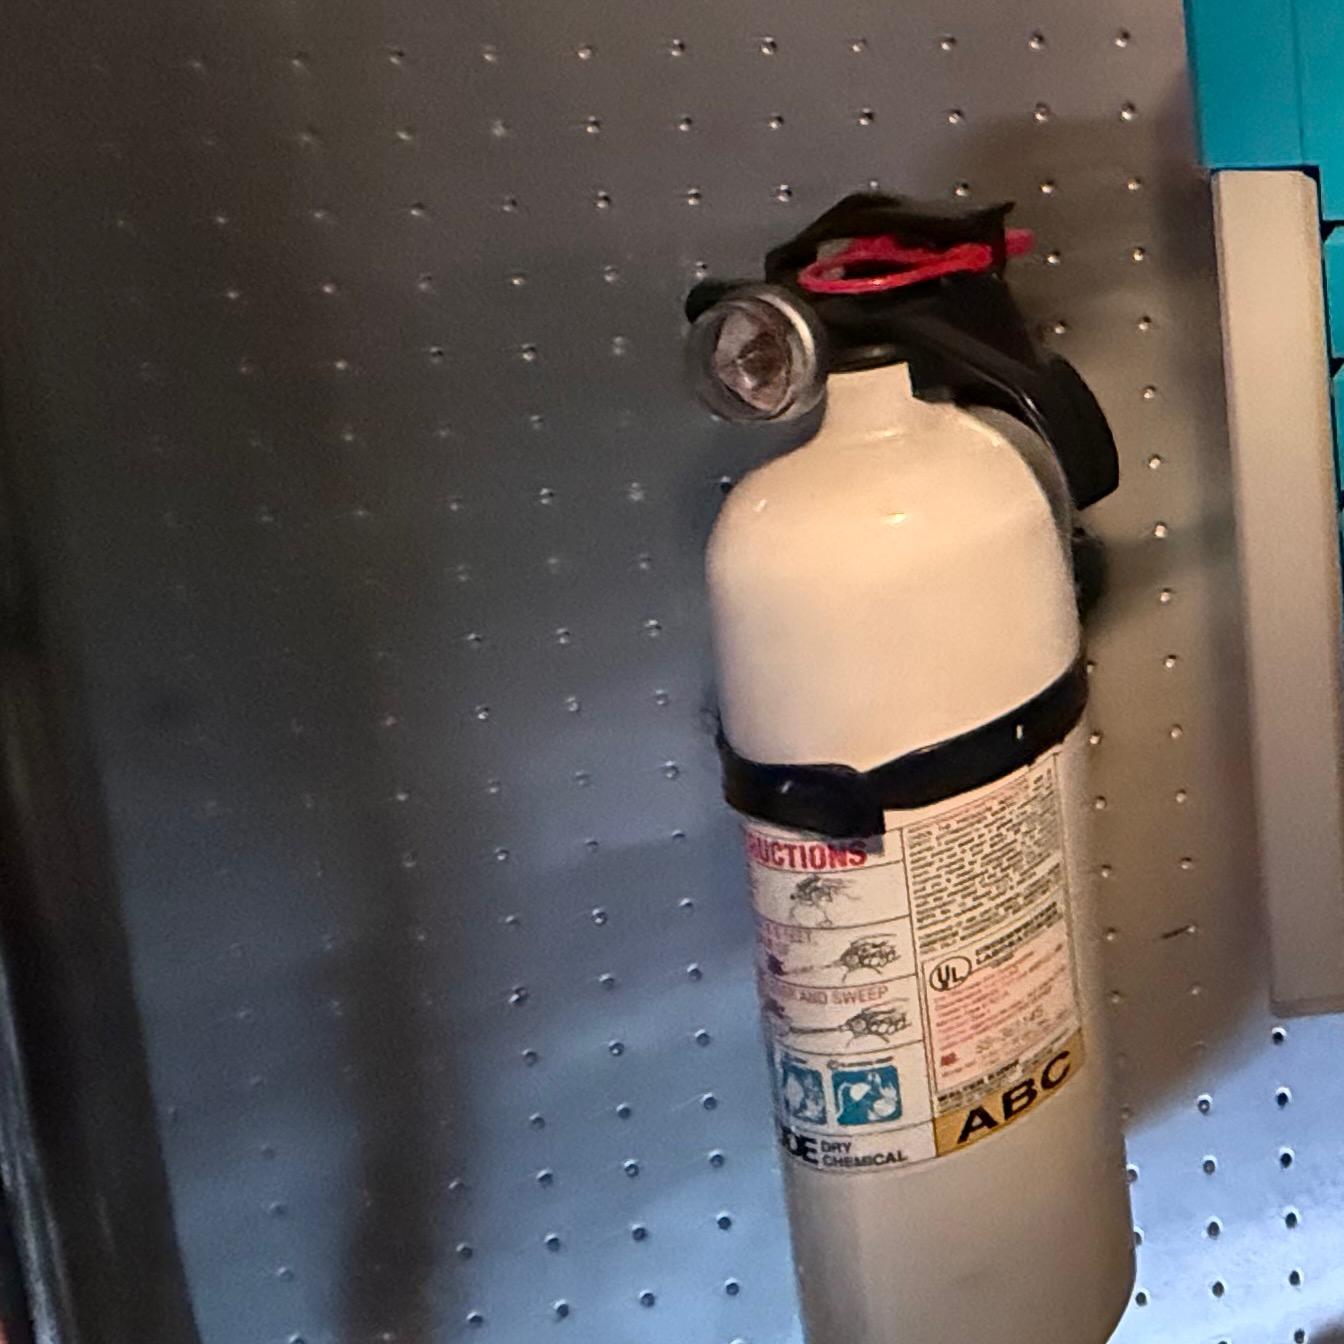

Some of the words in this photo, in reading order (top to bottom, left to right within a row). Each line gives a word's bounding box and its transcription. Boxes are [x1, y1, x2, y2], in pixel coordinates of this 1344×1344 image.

[832, 985, 889, 1005] SWEEP
[957, 1050, 1071, 1144] ABC
[820, 1140, 852, 1154] DRY
[821, 1150, 909, 1168] CHEMICAL
